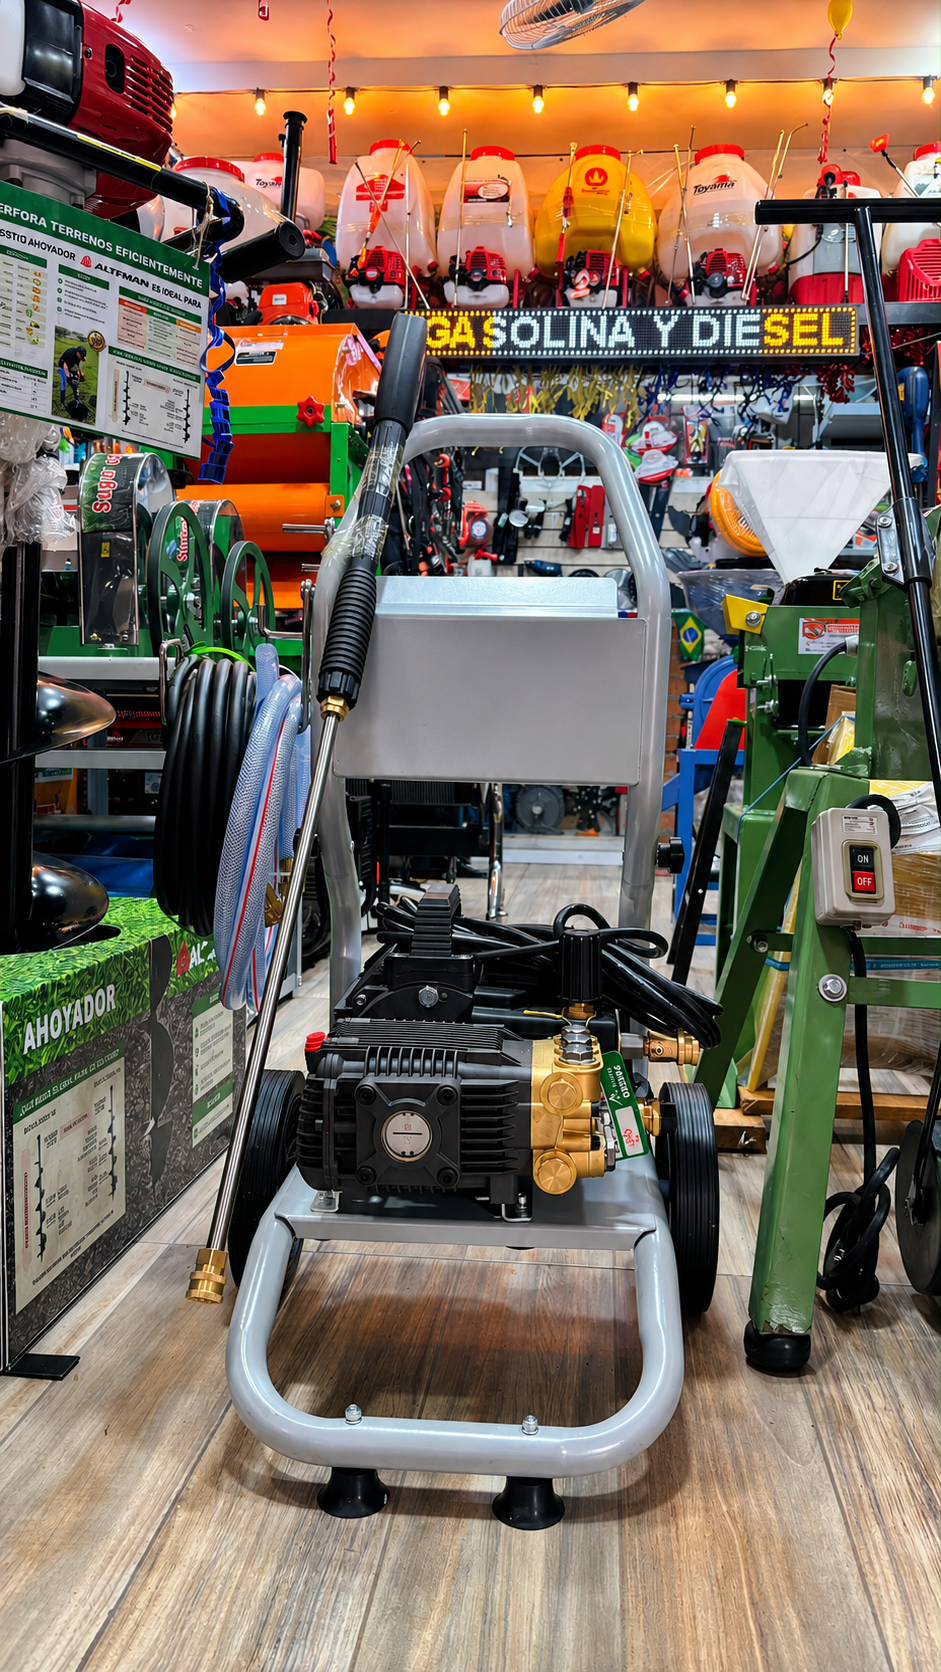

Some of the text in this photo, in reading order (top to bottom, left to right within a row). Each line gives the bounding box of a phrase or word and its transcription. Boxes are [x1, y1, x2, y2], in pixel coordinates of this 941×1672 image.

[693, 181, 735, 196] Toyama
[50, 220, 113, 252] TERRENOS
[115, 244, 203, 289] EFICIENTEMENTE
[28, 238, 76, 262] AHOYADOR
[151, 283, 161, 294] ES
[162, 287, 183, 302] IDEAL
[183, 295, 202, 309] PARA
[426, 312, 844, 349] GASOLINA Y DIESEL
[857, 854, 869, 864] ON
[857, 876, 872, 887] OFF
[22, 983, 116, 1056] AHOYADOR
